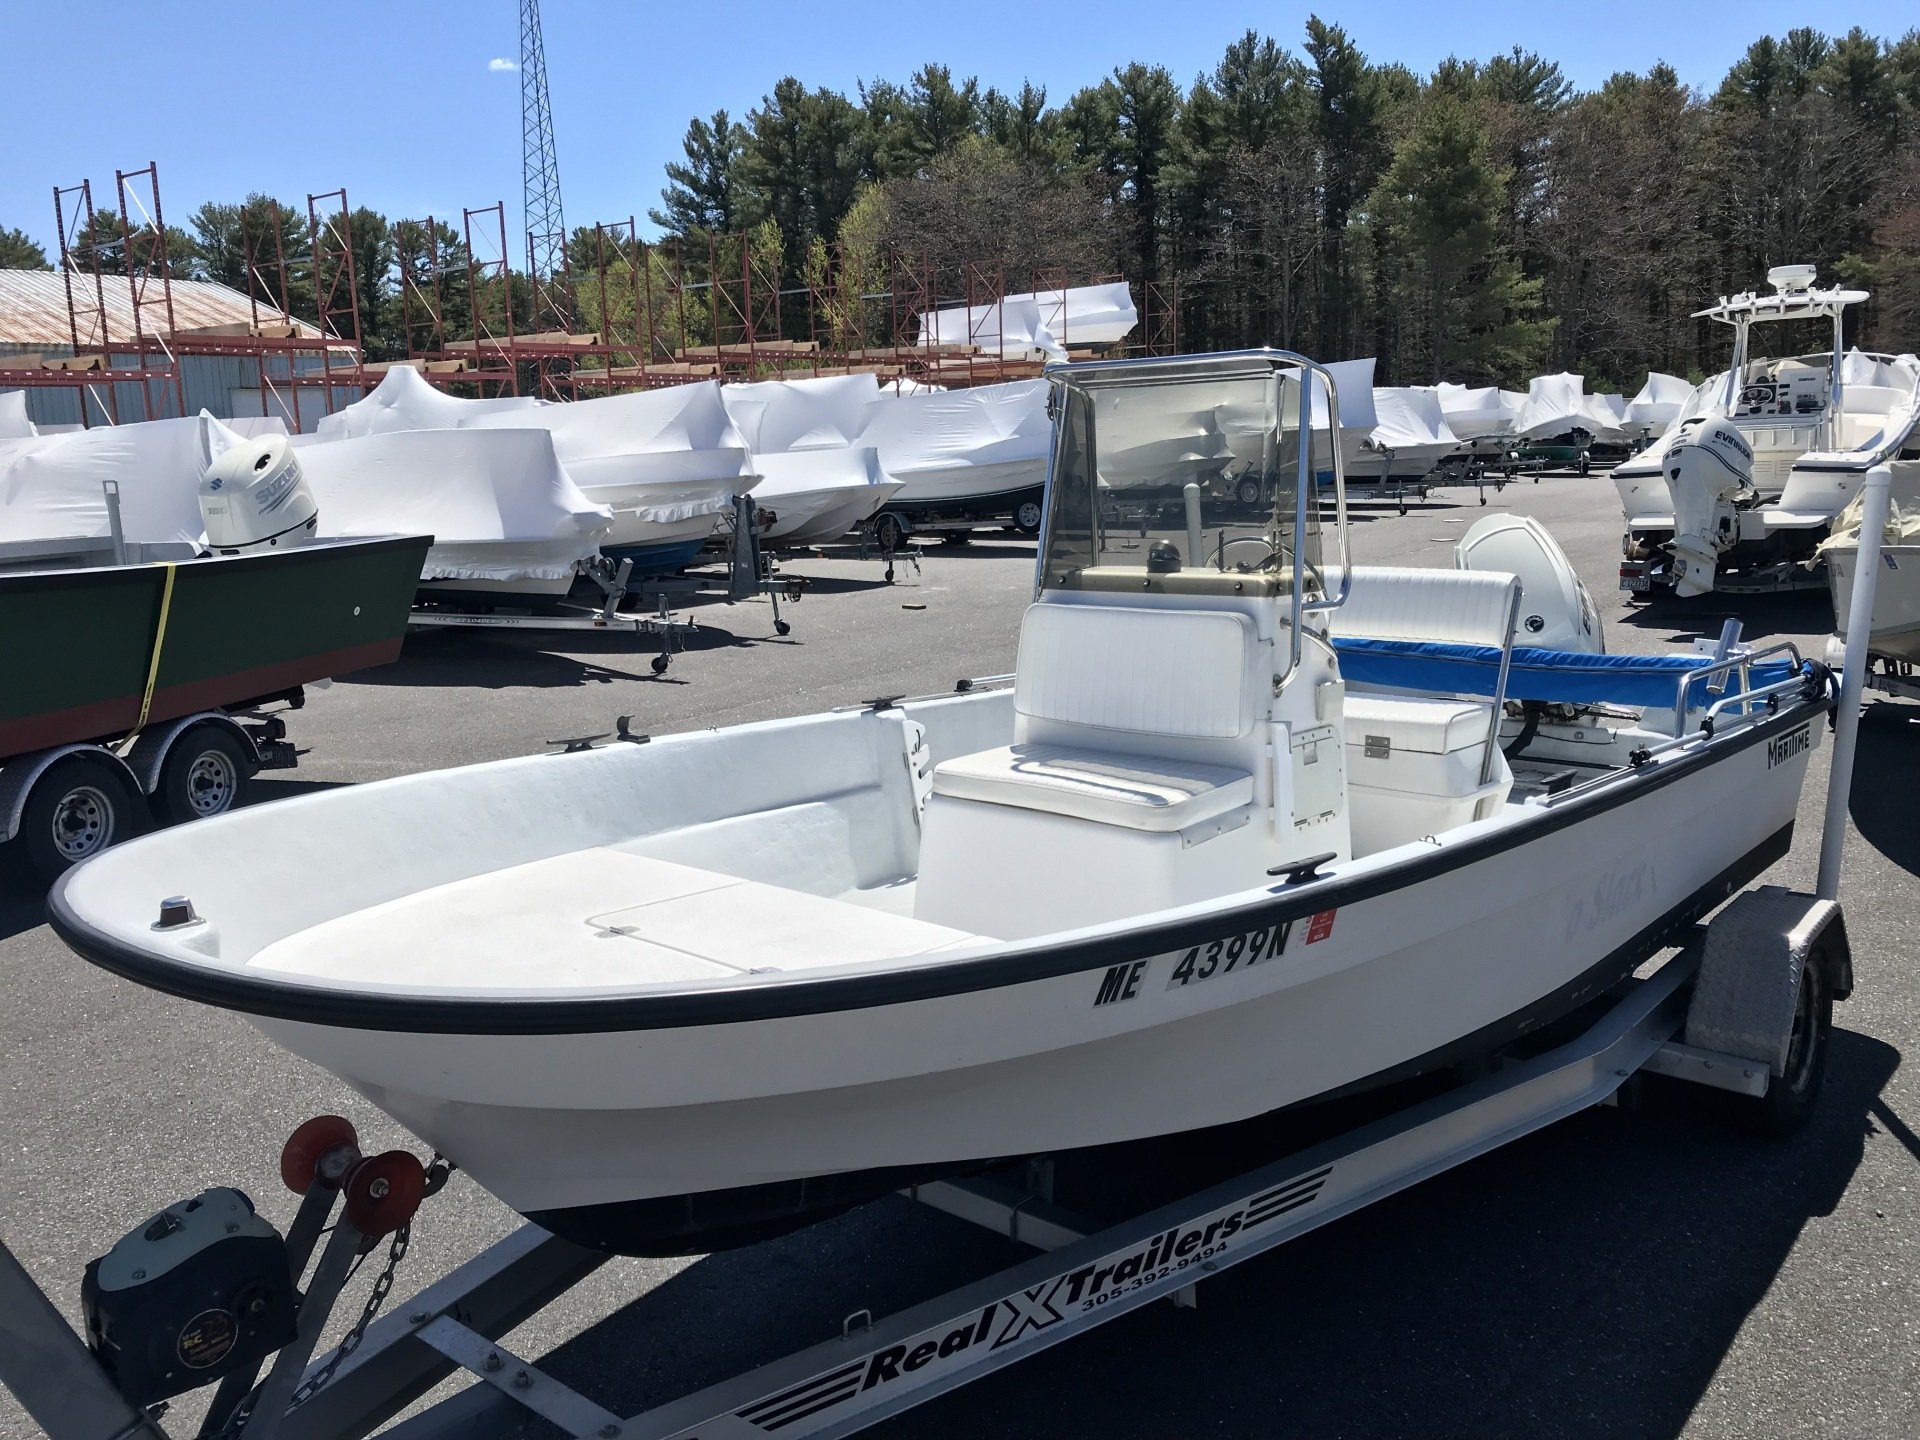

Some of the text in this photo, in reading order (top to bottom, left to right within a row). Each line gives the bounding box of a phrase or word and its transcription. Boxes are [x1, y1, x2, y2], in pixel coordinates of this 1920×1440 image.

[1093, 960, 1147, 1007] ME
[1171, 921, 1293, 986] 4399N
[861, 1210, 1245, 1392] Real X Trailers
[1081, 1241, 1228, 1312] 305-392-9494
